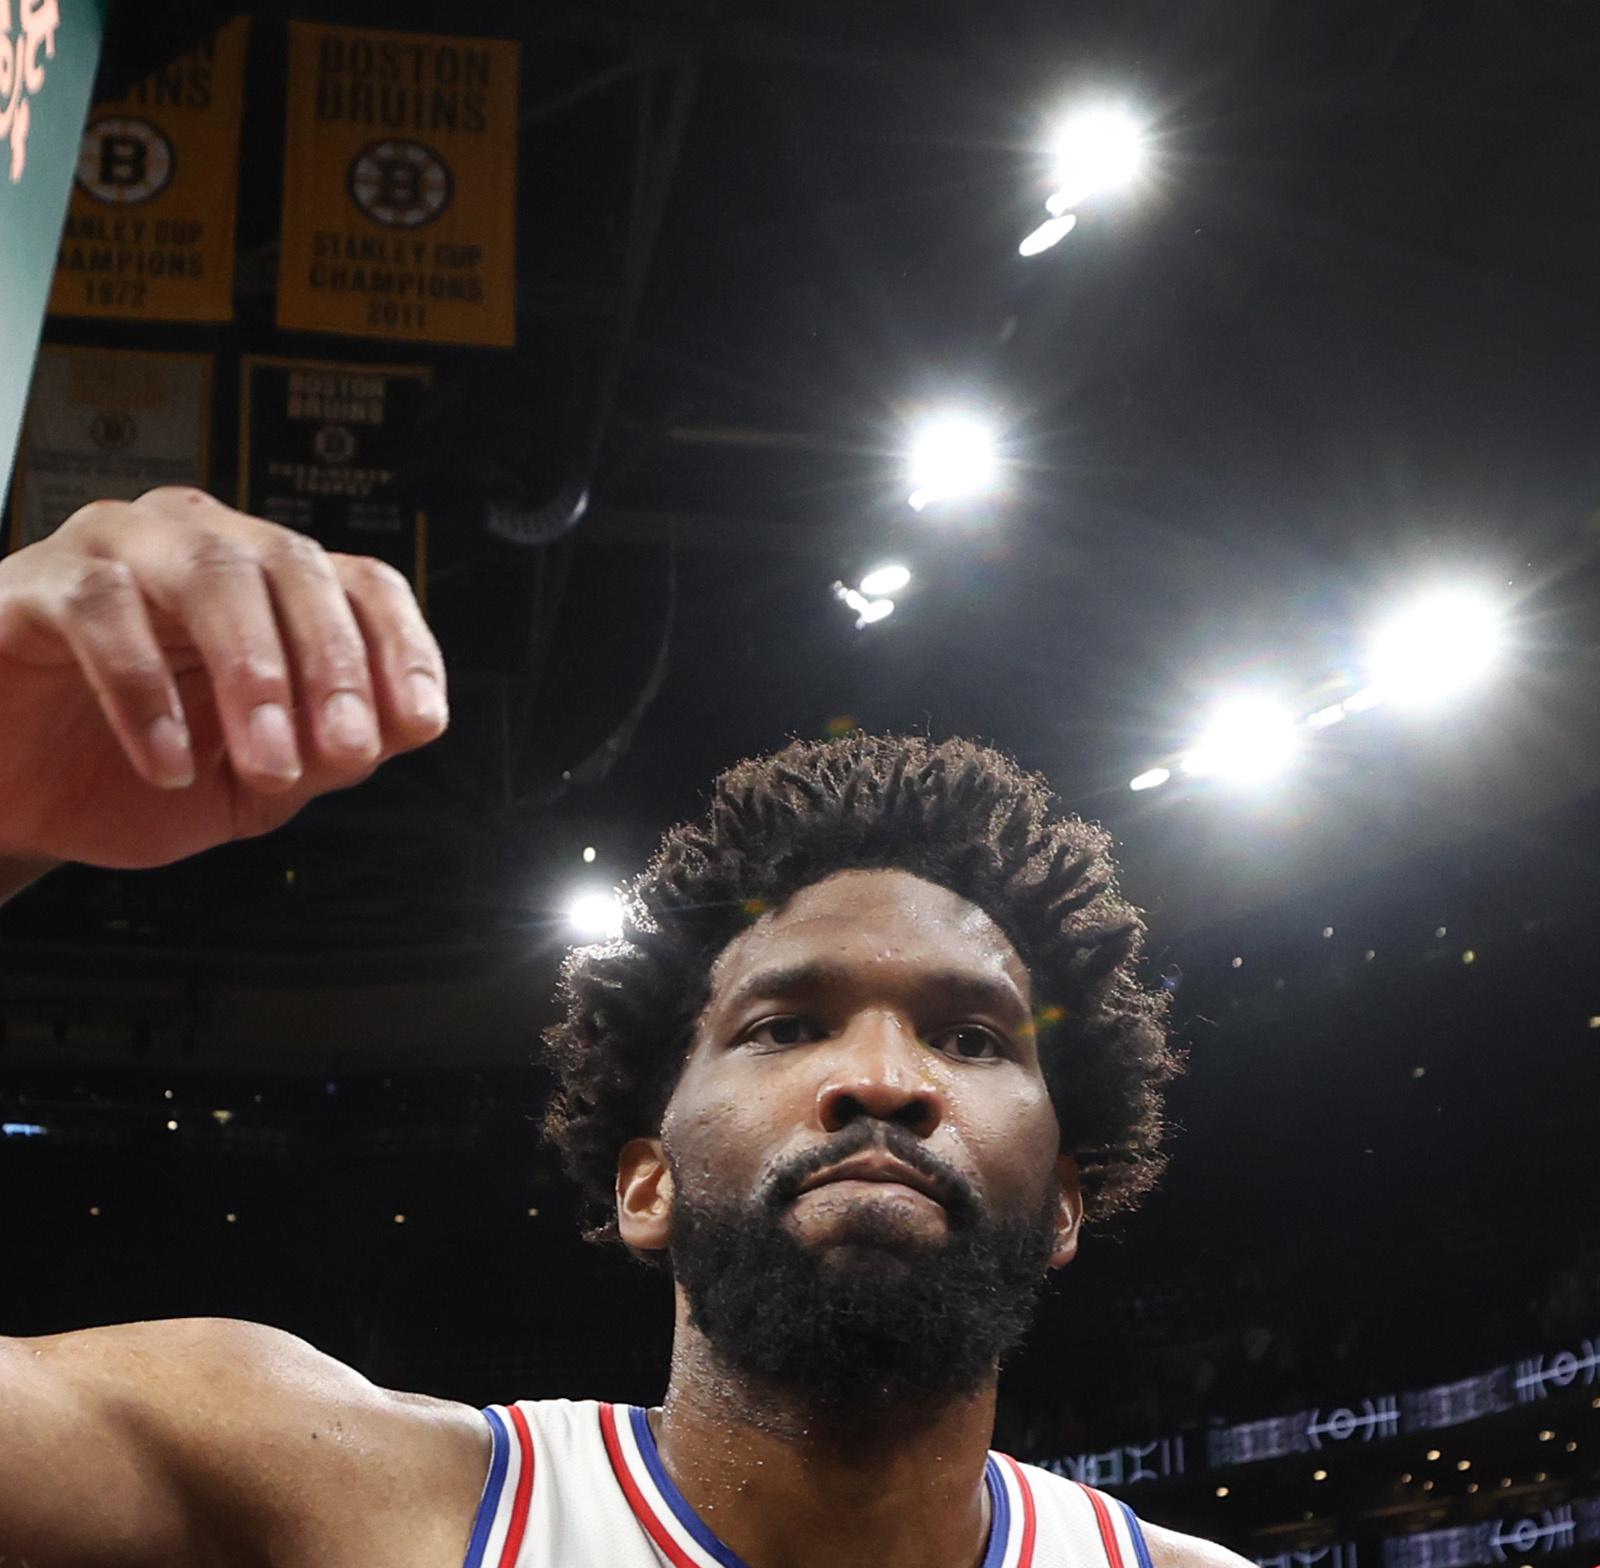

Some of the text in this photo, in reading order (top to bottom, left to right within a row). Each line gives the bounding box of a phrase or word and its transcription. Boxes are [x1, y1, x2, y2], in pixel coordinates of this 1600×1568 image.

[319, 33, 490, 87] BOSTON
[316, 81, 487, 134] BRUINS
[156, 219, 204, 246] CUP
[312, 231, 483, 271] STANLEY CUP
[308, 265, 484, 303] CHAMPIONS
